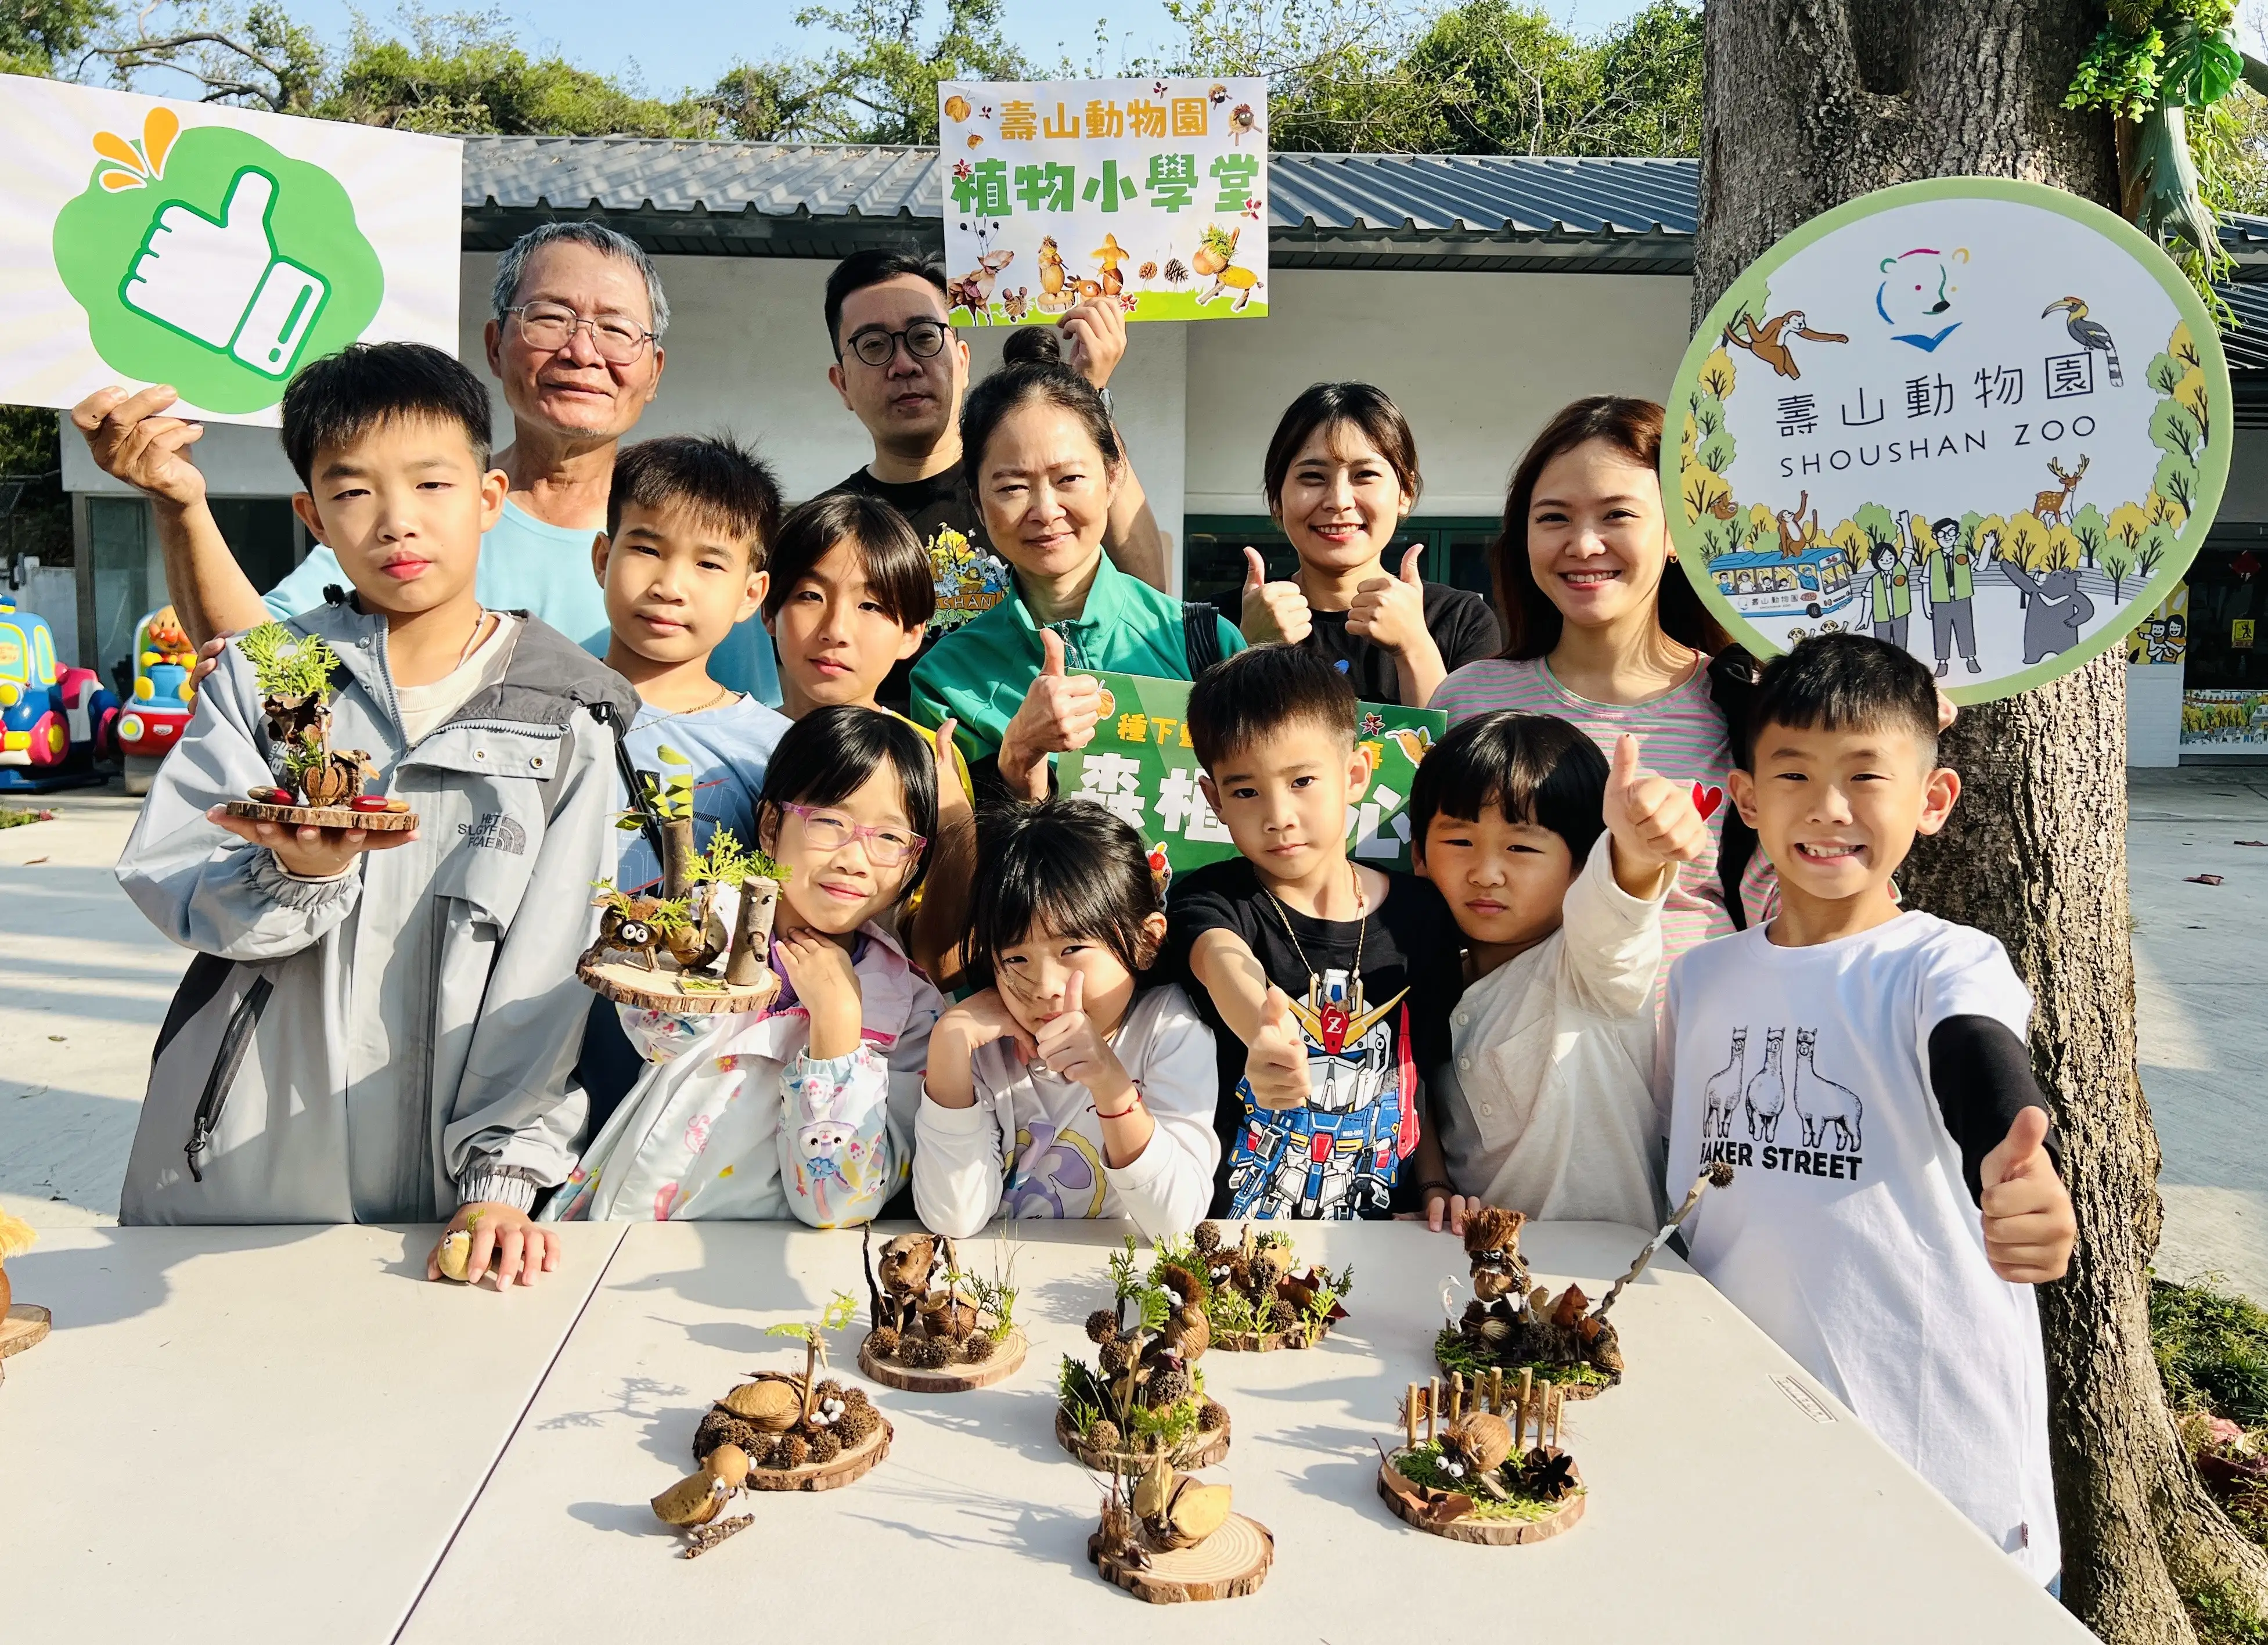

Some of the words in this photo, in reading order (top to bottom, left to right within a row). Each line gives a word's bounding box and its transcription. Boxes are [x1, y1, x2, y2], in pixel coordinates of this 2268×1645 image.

[999, 98, 1208, 140] 壽山動物園
[951, 153, 1259, 217] 植物小學堂
[1776, 352, 2094, 437] 壽山動物園
[1781, 430, 1986, 477] SHOUSHAN
[2014, 416, 2095, 446] ZOO
[1762, 1146, 1862, 1180] STREET
